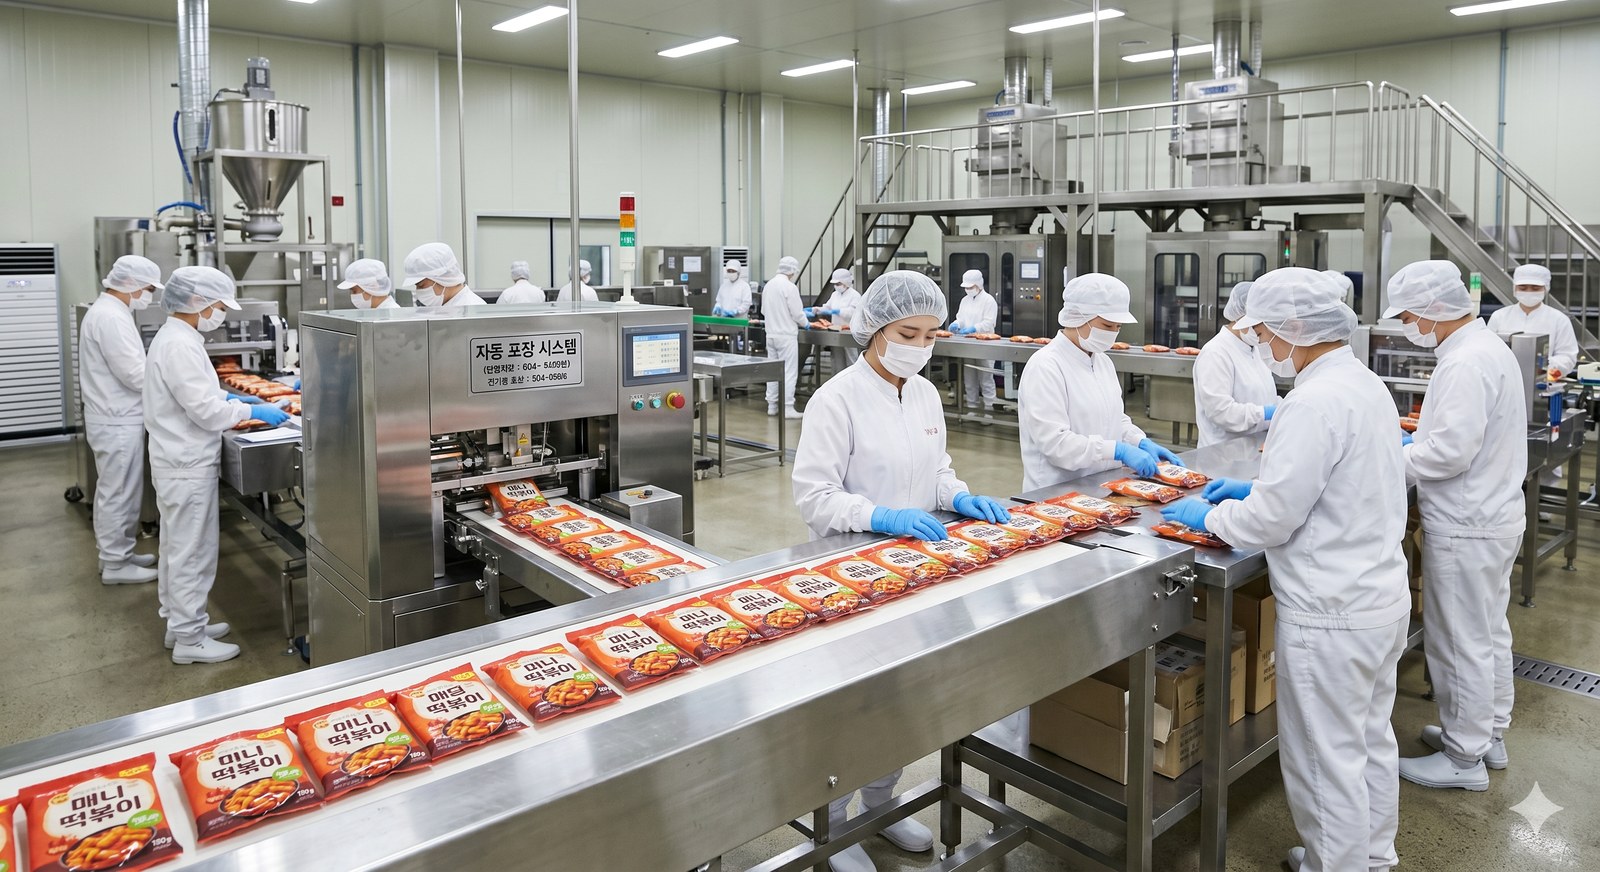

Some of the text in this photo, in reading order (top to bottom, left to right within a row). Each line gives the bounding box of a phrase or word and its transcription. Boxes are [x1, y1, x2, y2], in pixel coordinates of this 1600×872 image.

[475, 338, 577, 361] 자동 포장 시스템
[737, 592, 766, 604] 미니
[679, 610, 709, 622] 미니
[608, 630, 641, 644] 미니
[610, 635, 658, 654] 떡볶이
[523, 656, 559, 672] 미니
[524, 662, 577, 682] 떡볶이
[426, 692, 485, 714] 떡볶이
[333, 713, 373, 733] 미니
[327, 721, 392, 747] 떡볶이
[218, 745, 264, 766] 미니
[211, 754, 282, 781] 떡볶이
[71, 785, 124, 811] 매니
[60, 795, 142, 828] 떡볶이
